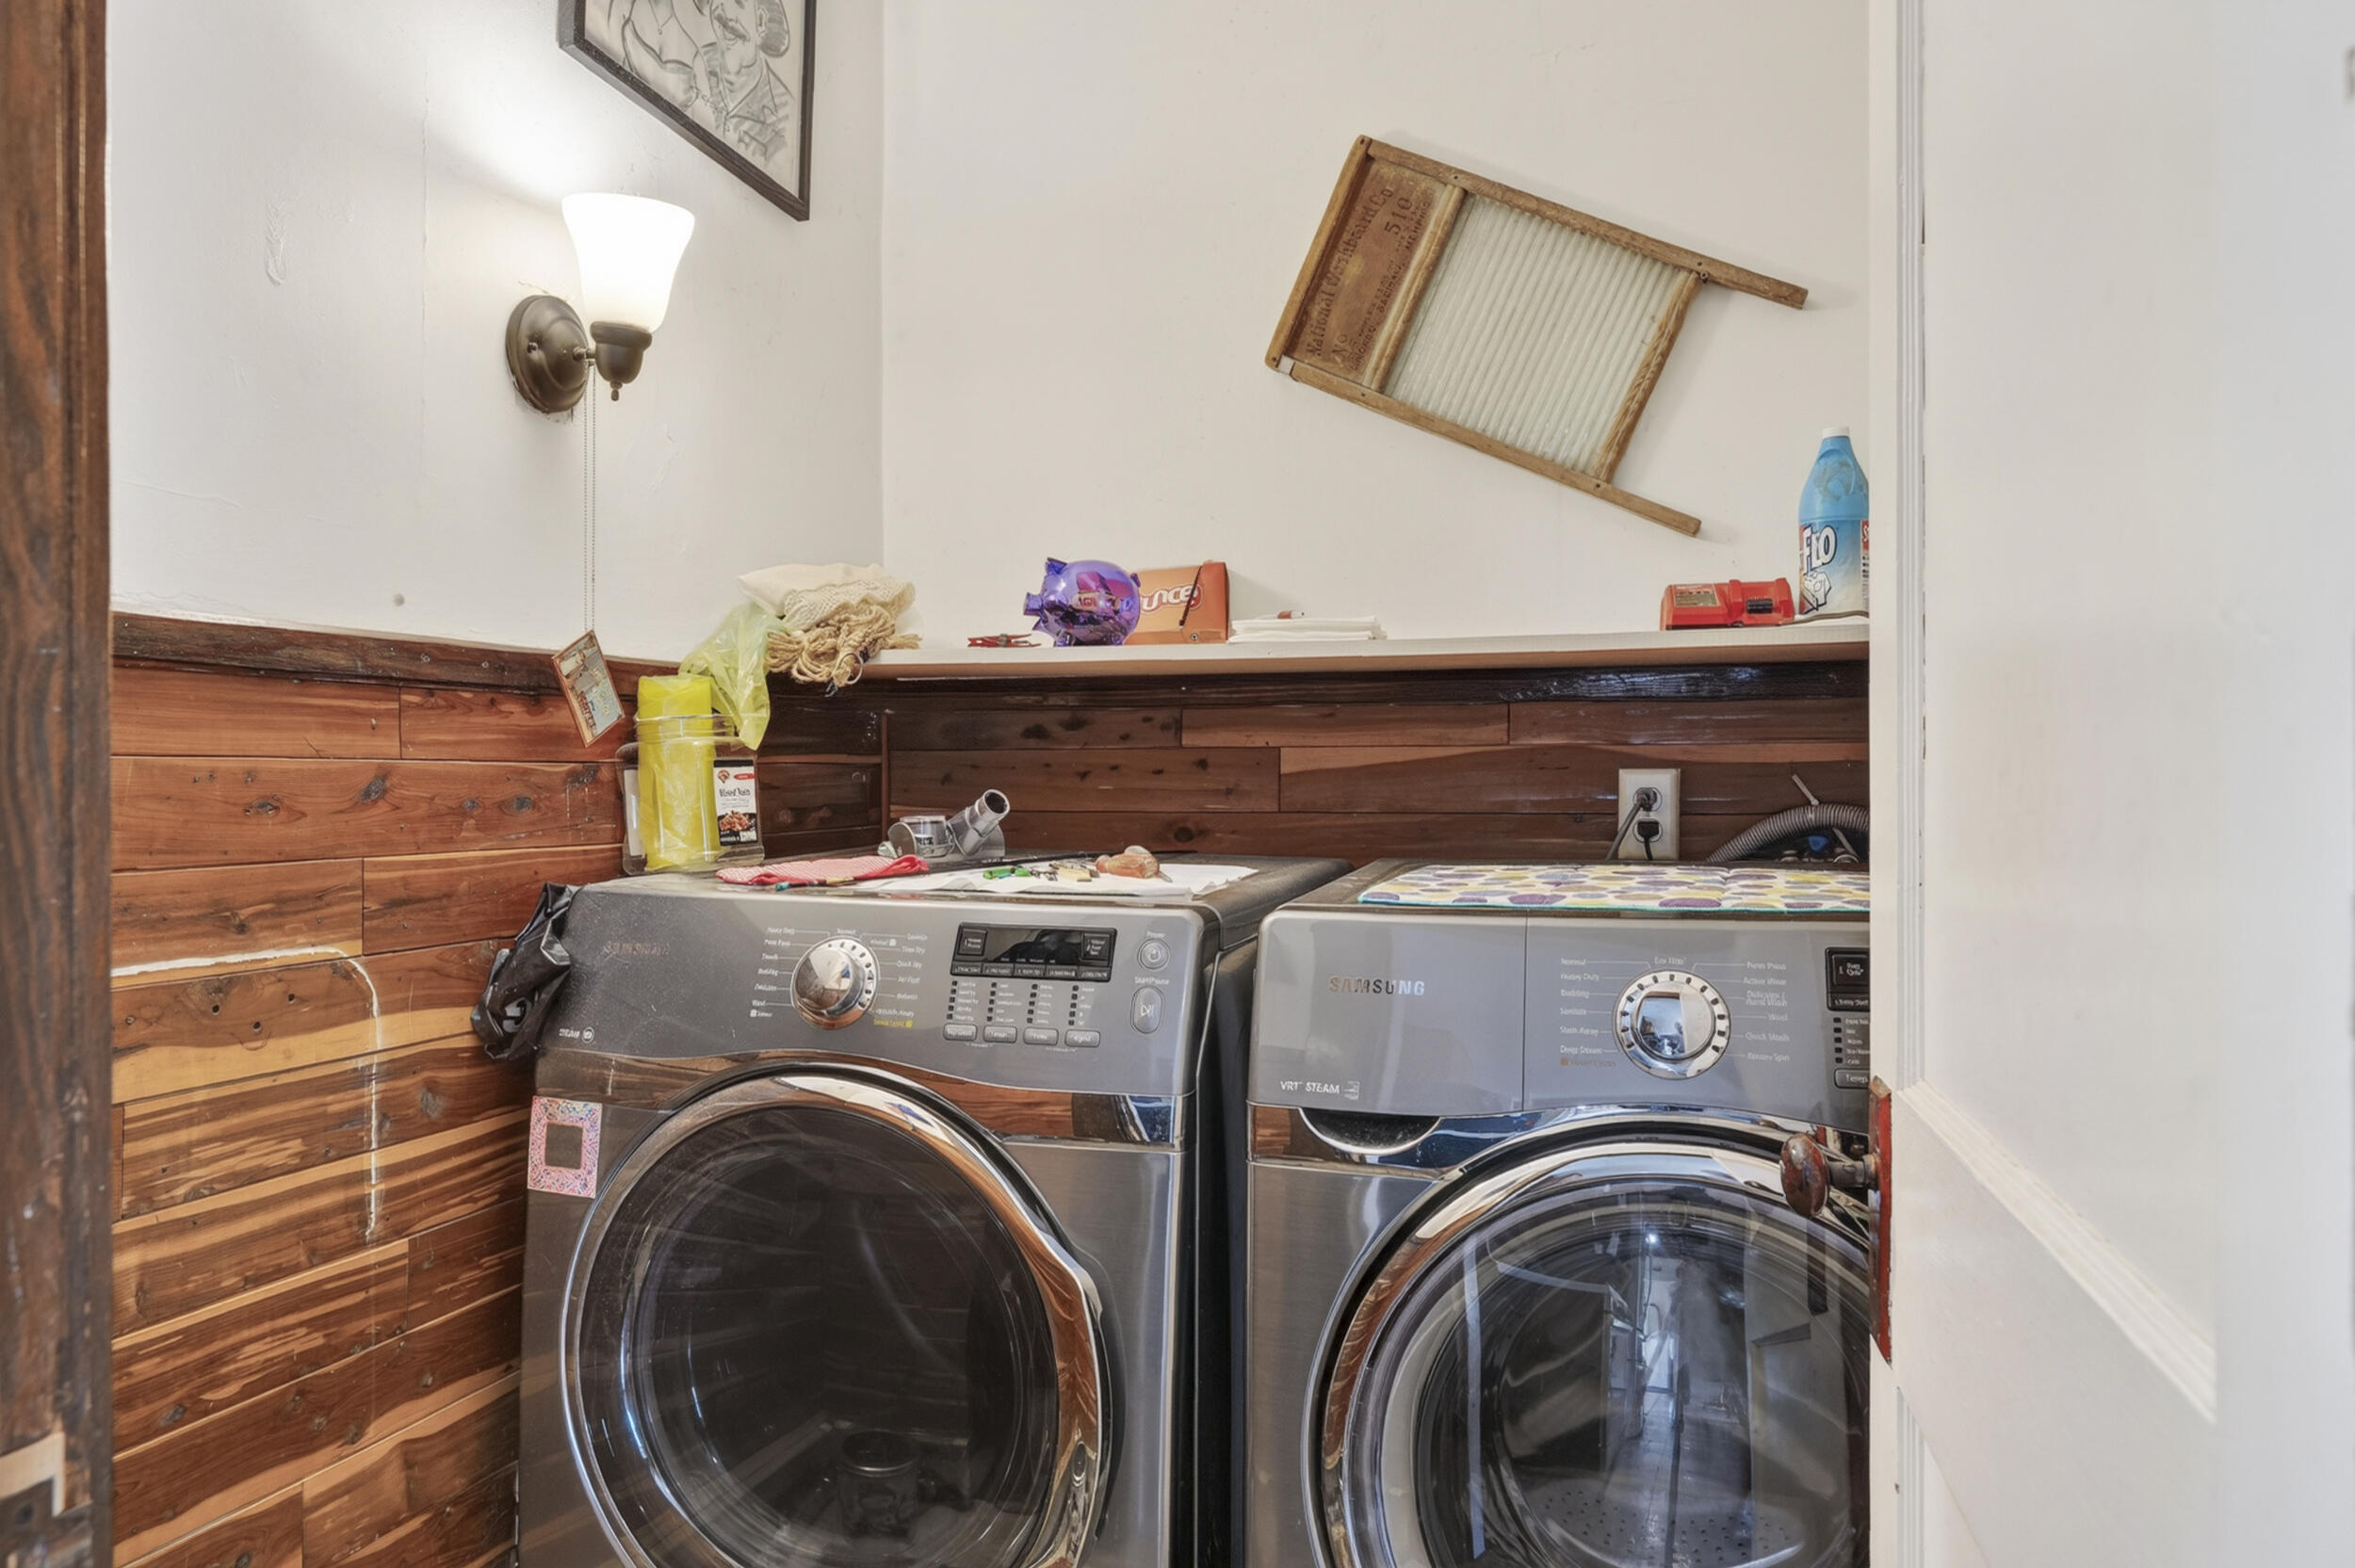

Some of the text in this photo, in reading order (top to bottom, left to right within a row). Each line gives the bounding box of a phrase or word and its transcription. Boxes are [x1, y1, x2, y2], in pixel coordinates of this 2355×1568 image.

[1384, 196, 1414, 236] 510
[1328, 976, 1425, 995] SAMSUNG
[1305, 1081, 1340, 1094] STEAM
